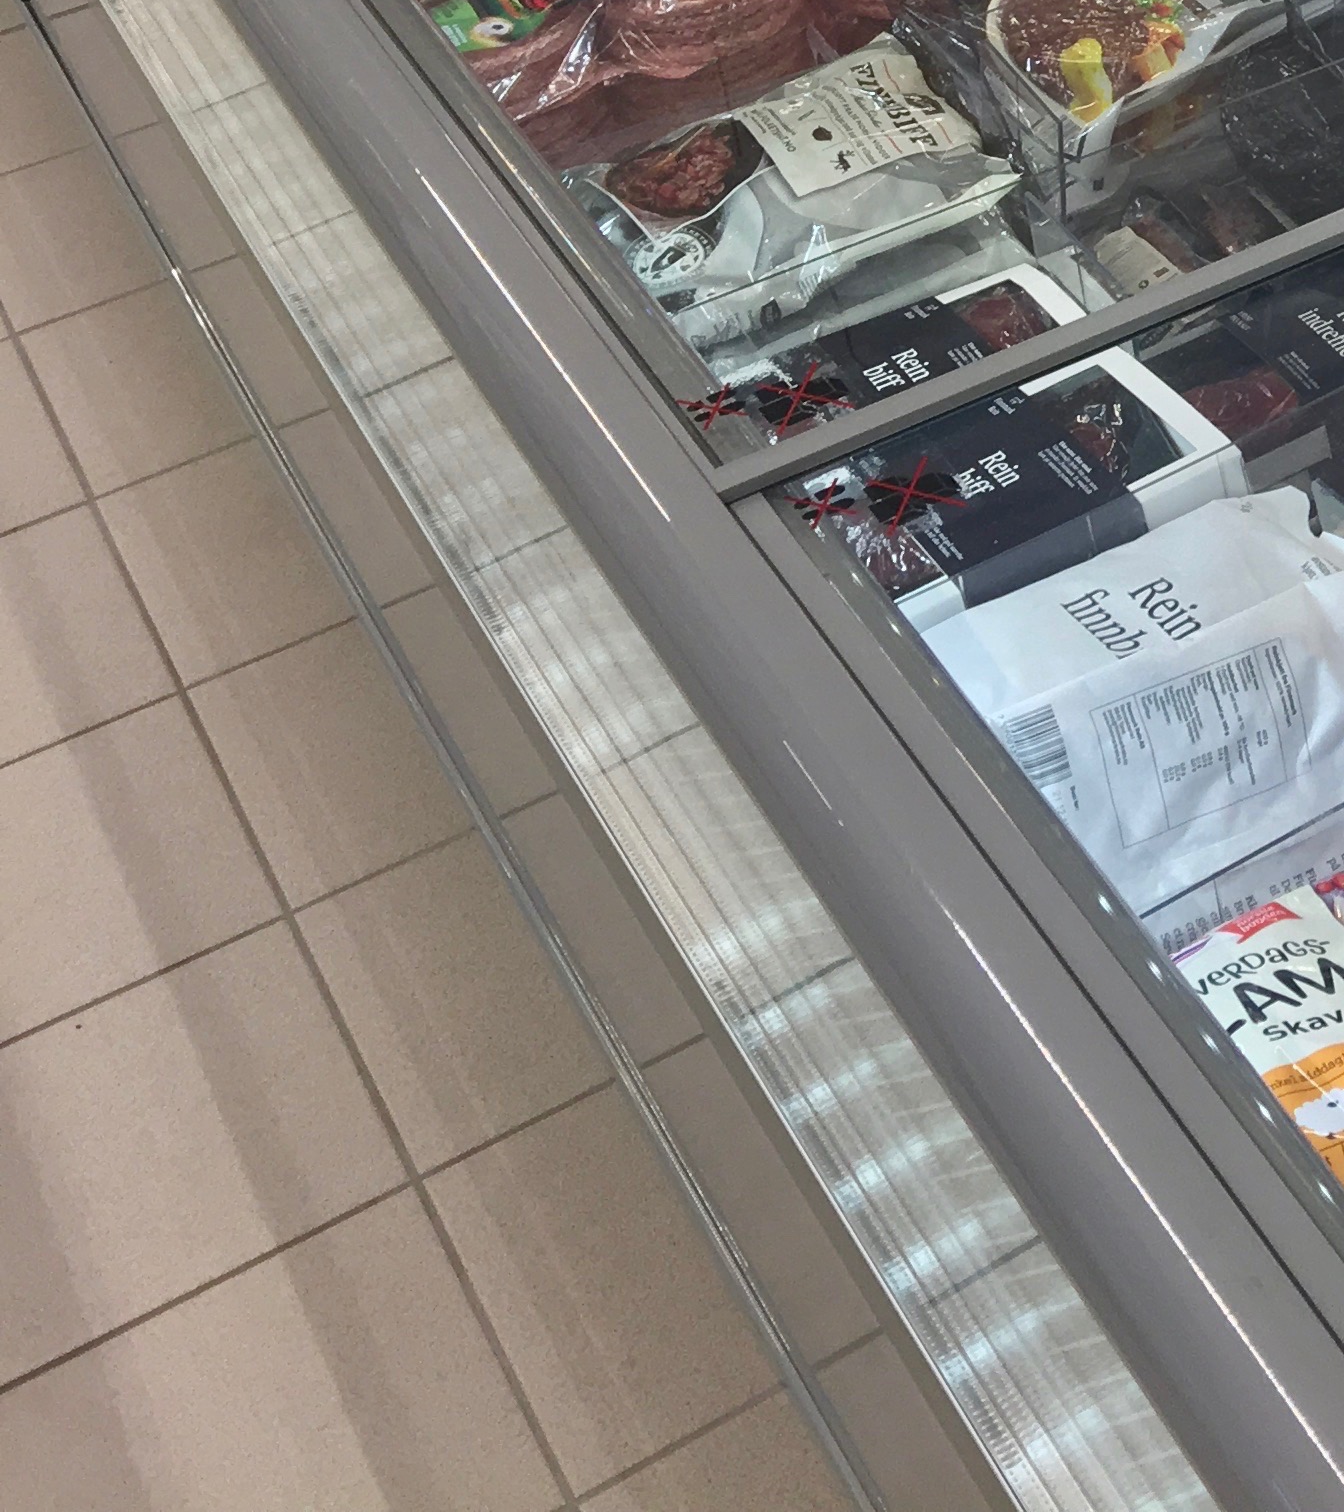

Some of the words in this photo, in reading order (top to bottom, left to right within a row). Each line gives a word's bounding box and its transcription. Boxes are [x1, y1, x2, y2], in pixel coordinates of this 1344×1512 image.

[863, 360, 905, 395] biff
[890, 347, 930, 383] Rein
[958, 462, 996, 499] biff
[977, 449, 1021, 491] Rein
[1128, 574, 1204, 645] Rein
